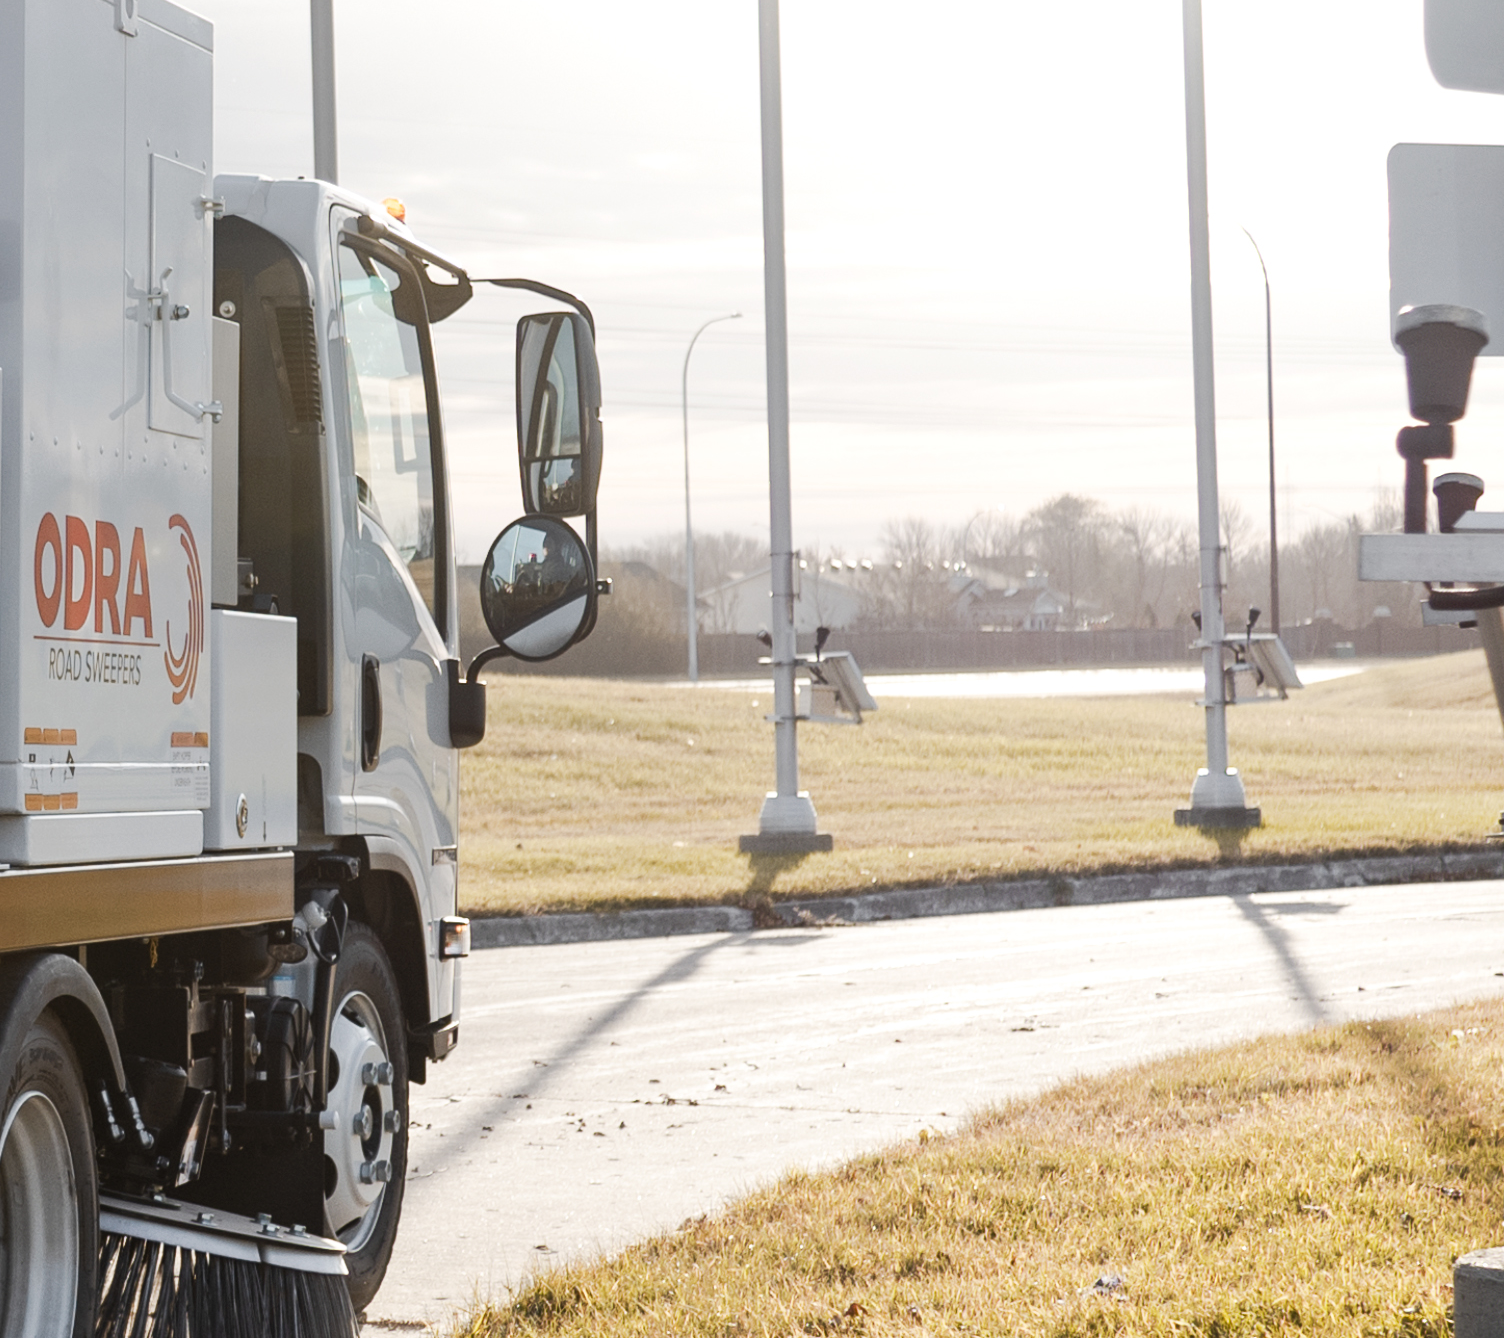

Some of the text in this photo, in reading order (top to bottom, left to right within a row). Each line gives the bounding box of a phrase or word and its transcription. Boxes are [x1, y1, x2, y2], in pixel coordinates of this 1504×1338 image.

[34, 511, 154, 639] ODRA
[48, 647, 142, 686] ROAD SWEEPERS
